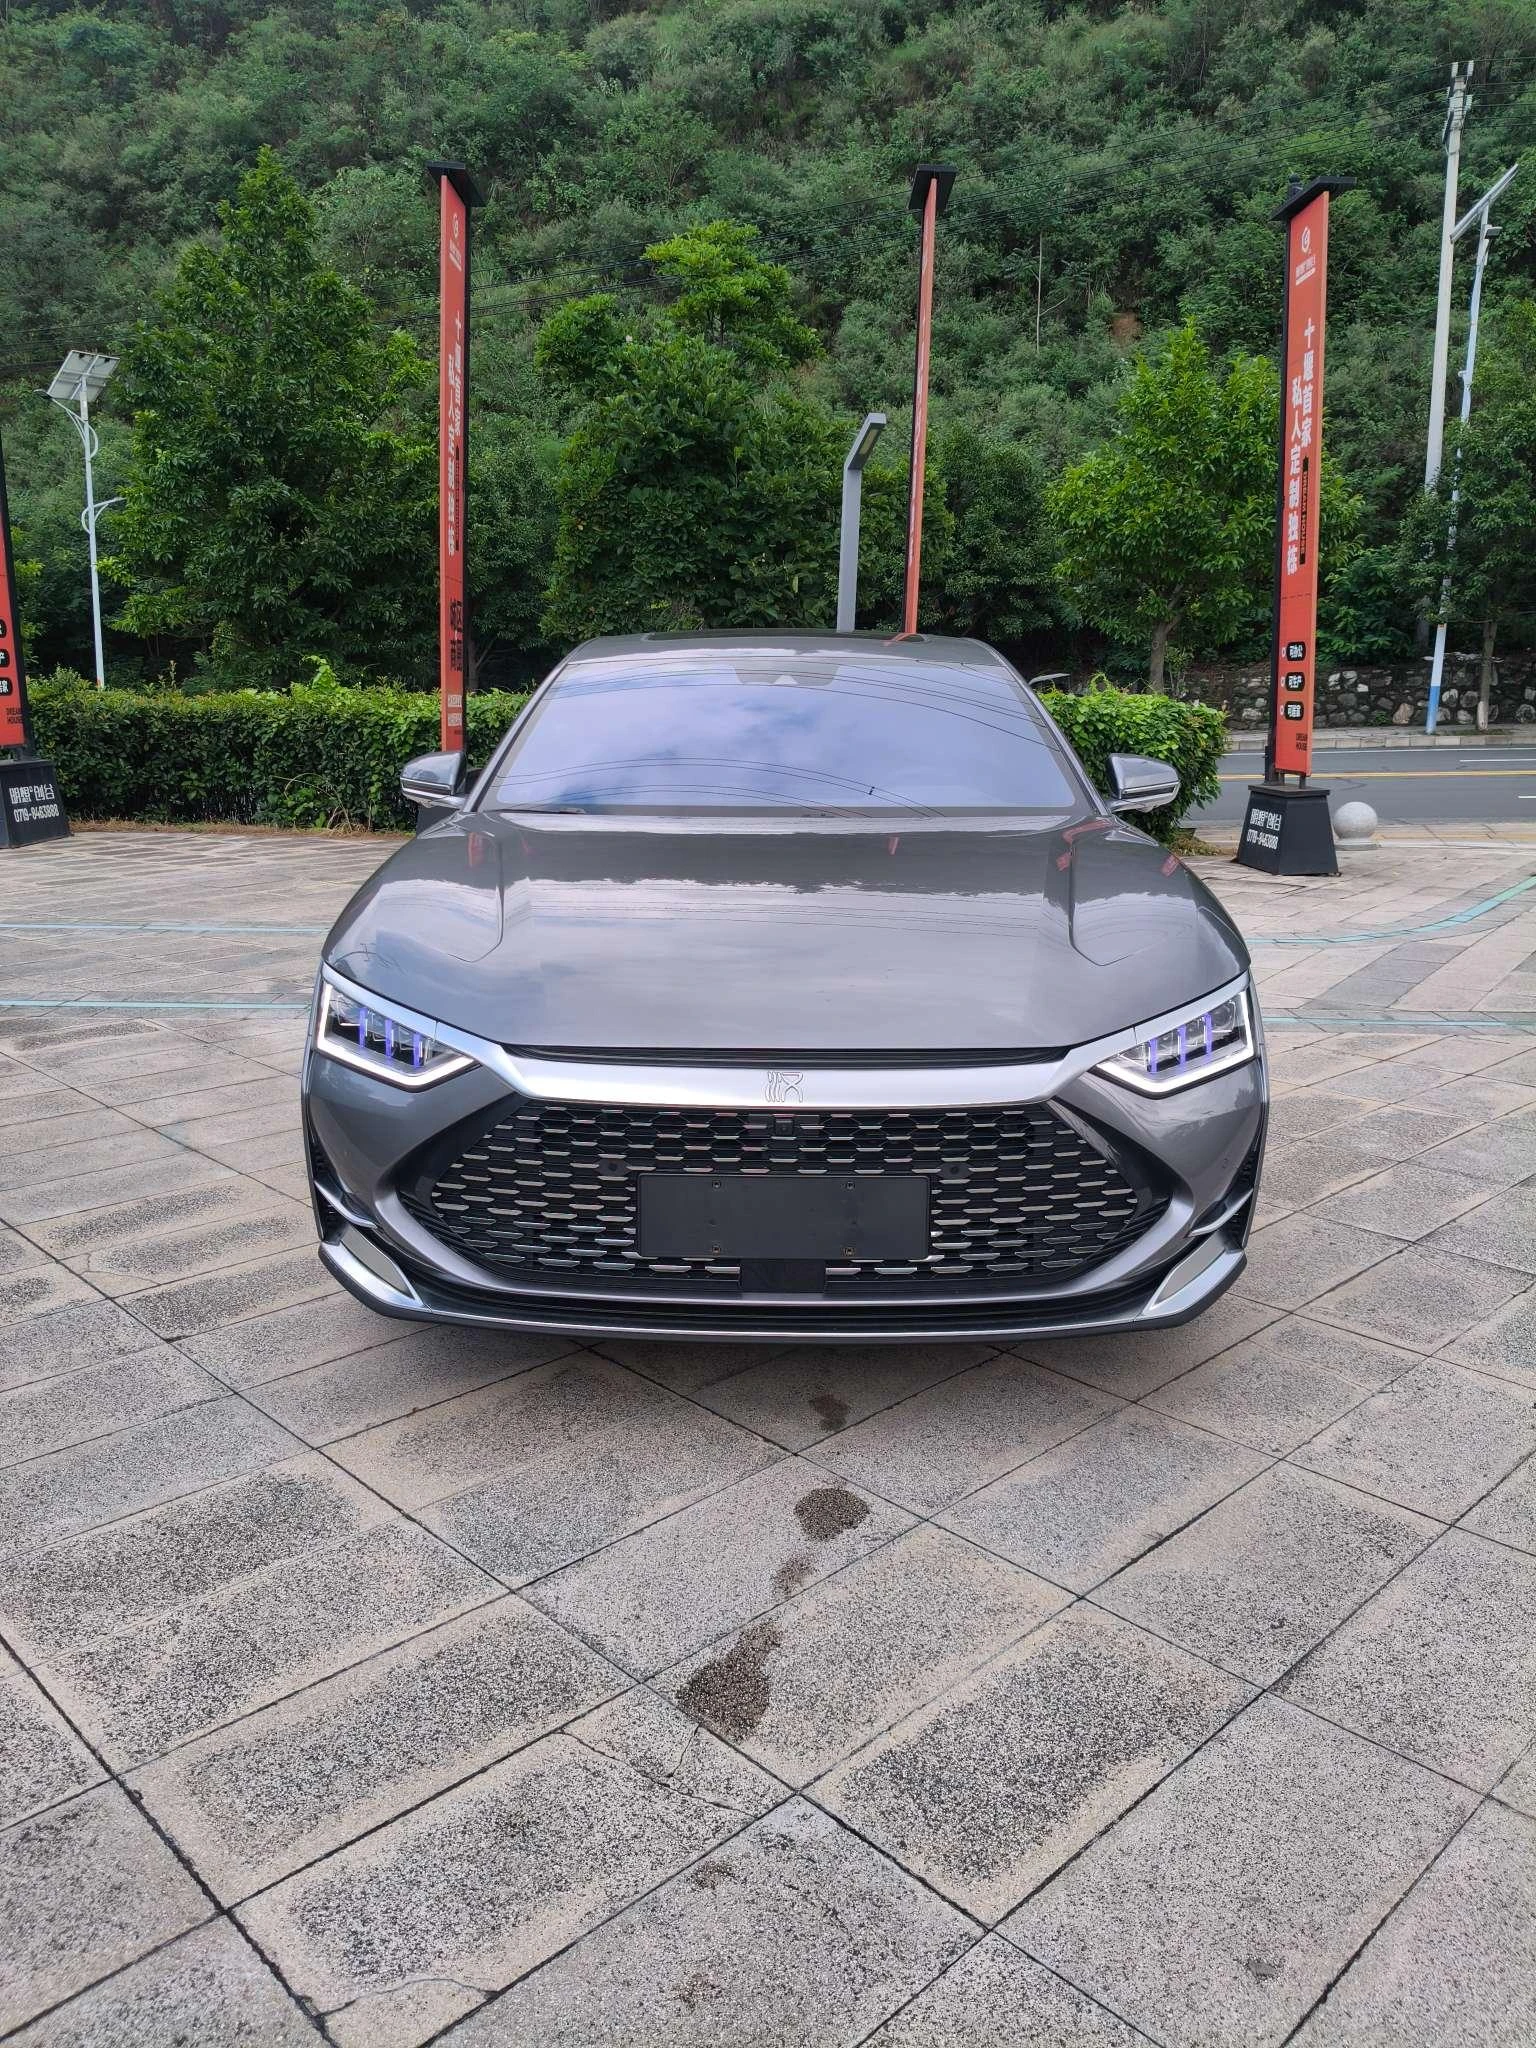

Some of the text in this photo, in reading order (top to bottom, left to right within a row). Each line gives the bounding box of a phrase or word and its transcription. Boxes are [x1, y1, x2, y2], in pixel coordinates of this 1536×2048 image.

[1301, 317, 1315, 448] 十堰首家
[1287, 375, 1302, 576] 私人定制独栋
